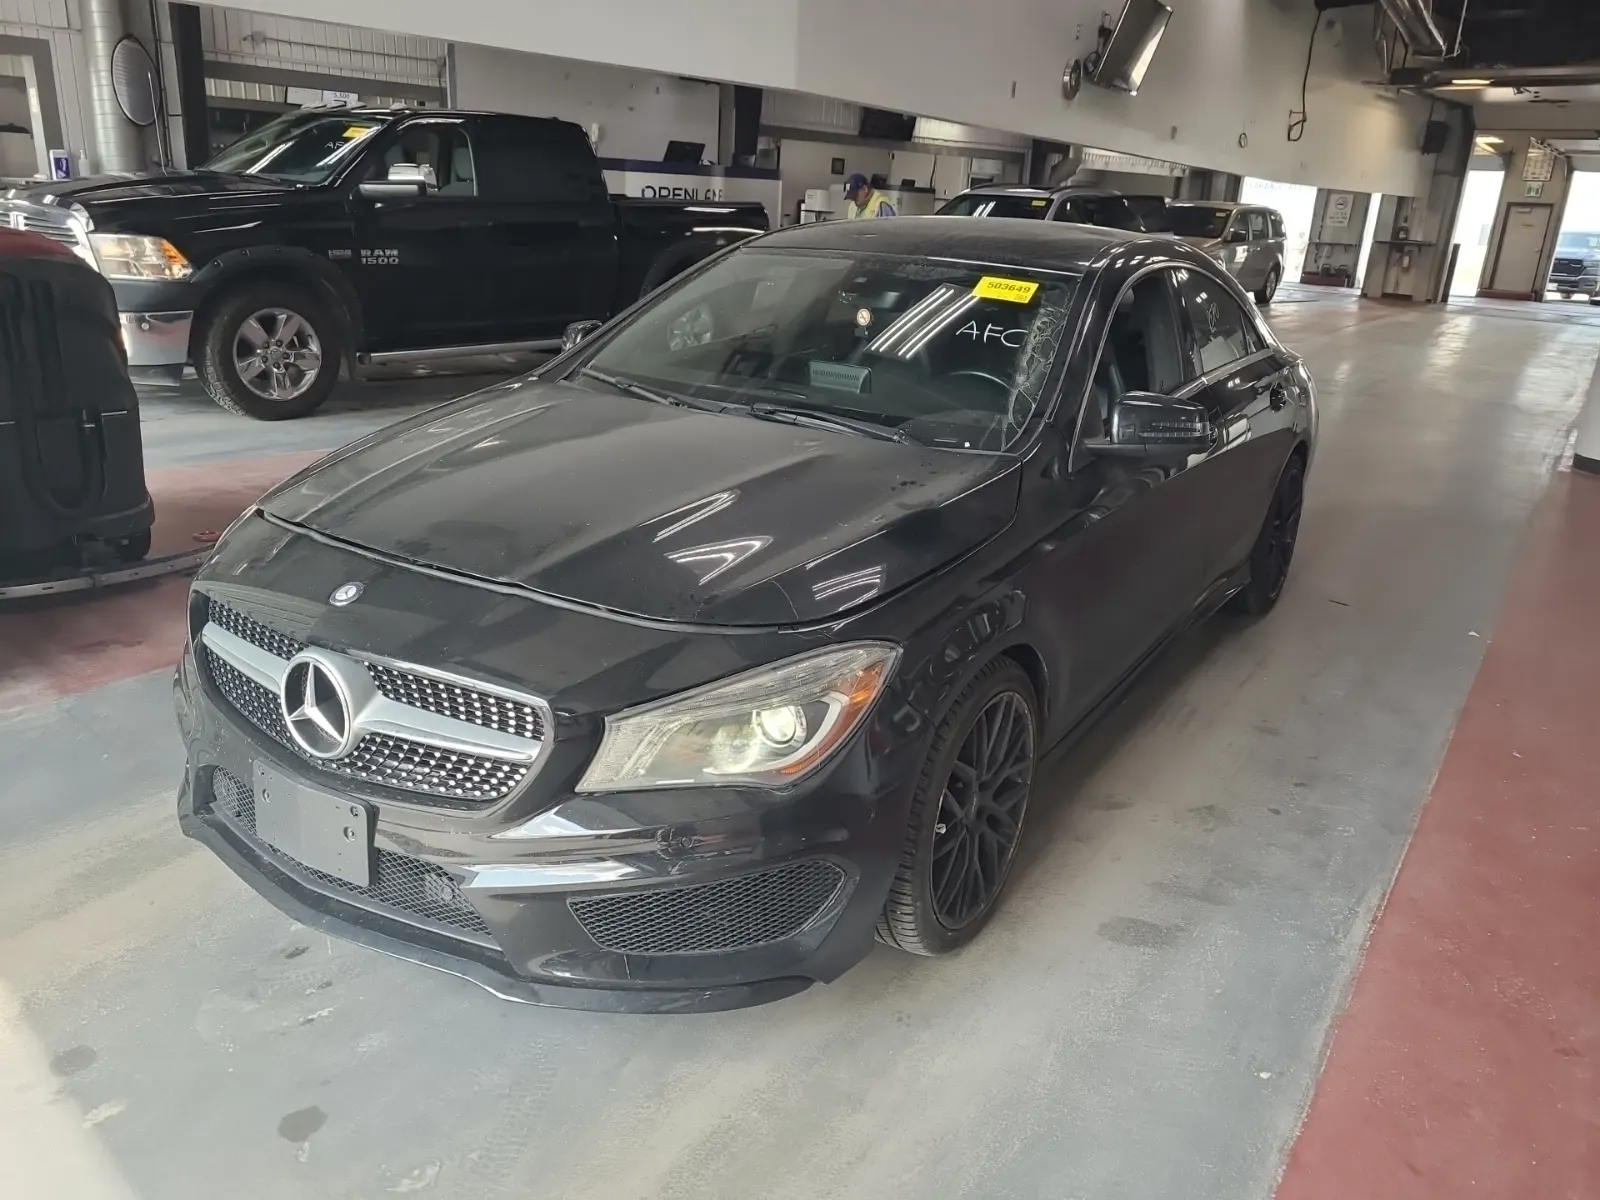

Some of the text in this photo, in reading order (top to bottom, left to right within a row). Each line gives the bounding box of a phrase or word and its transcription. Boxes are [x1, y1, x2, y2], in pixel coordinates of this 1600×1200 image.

[360, 249, 399, 257] RAM
[361, 257, 399, 265] 1500
[986, 281, 1031, 294] 503649
[955, 320, 1029, 348] AFC
